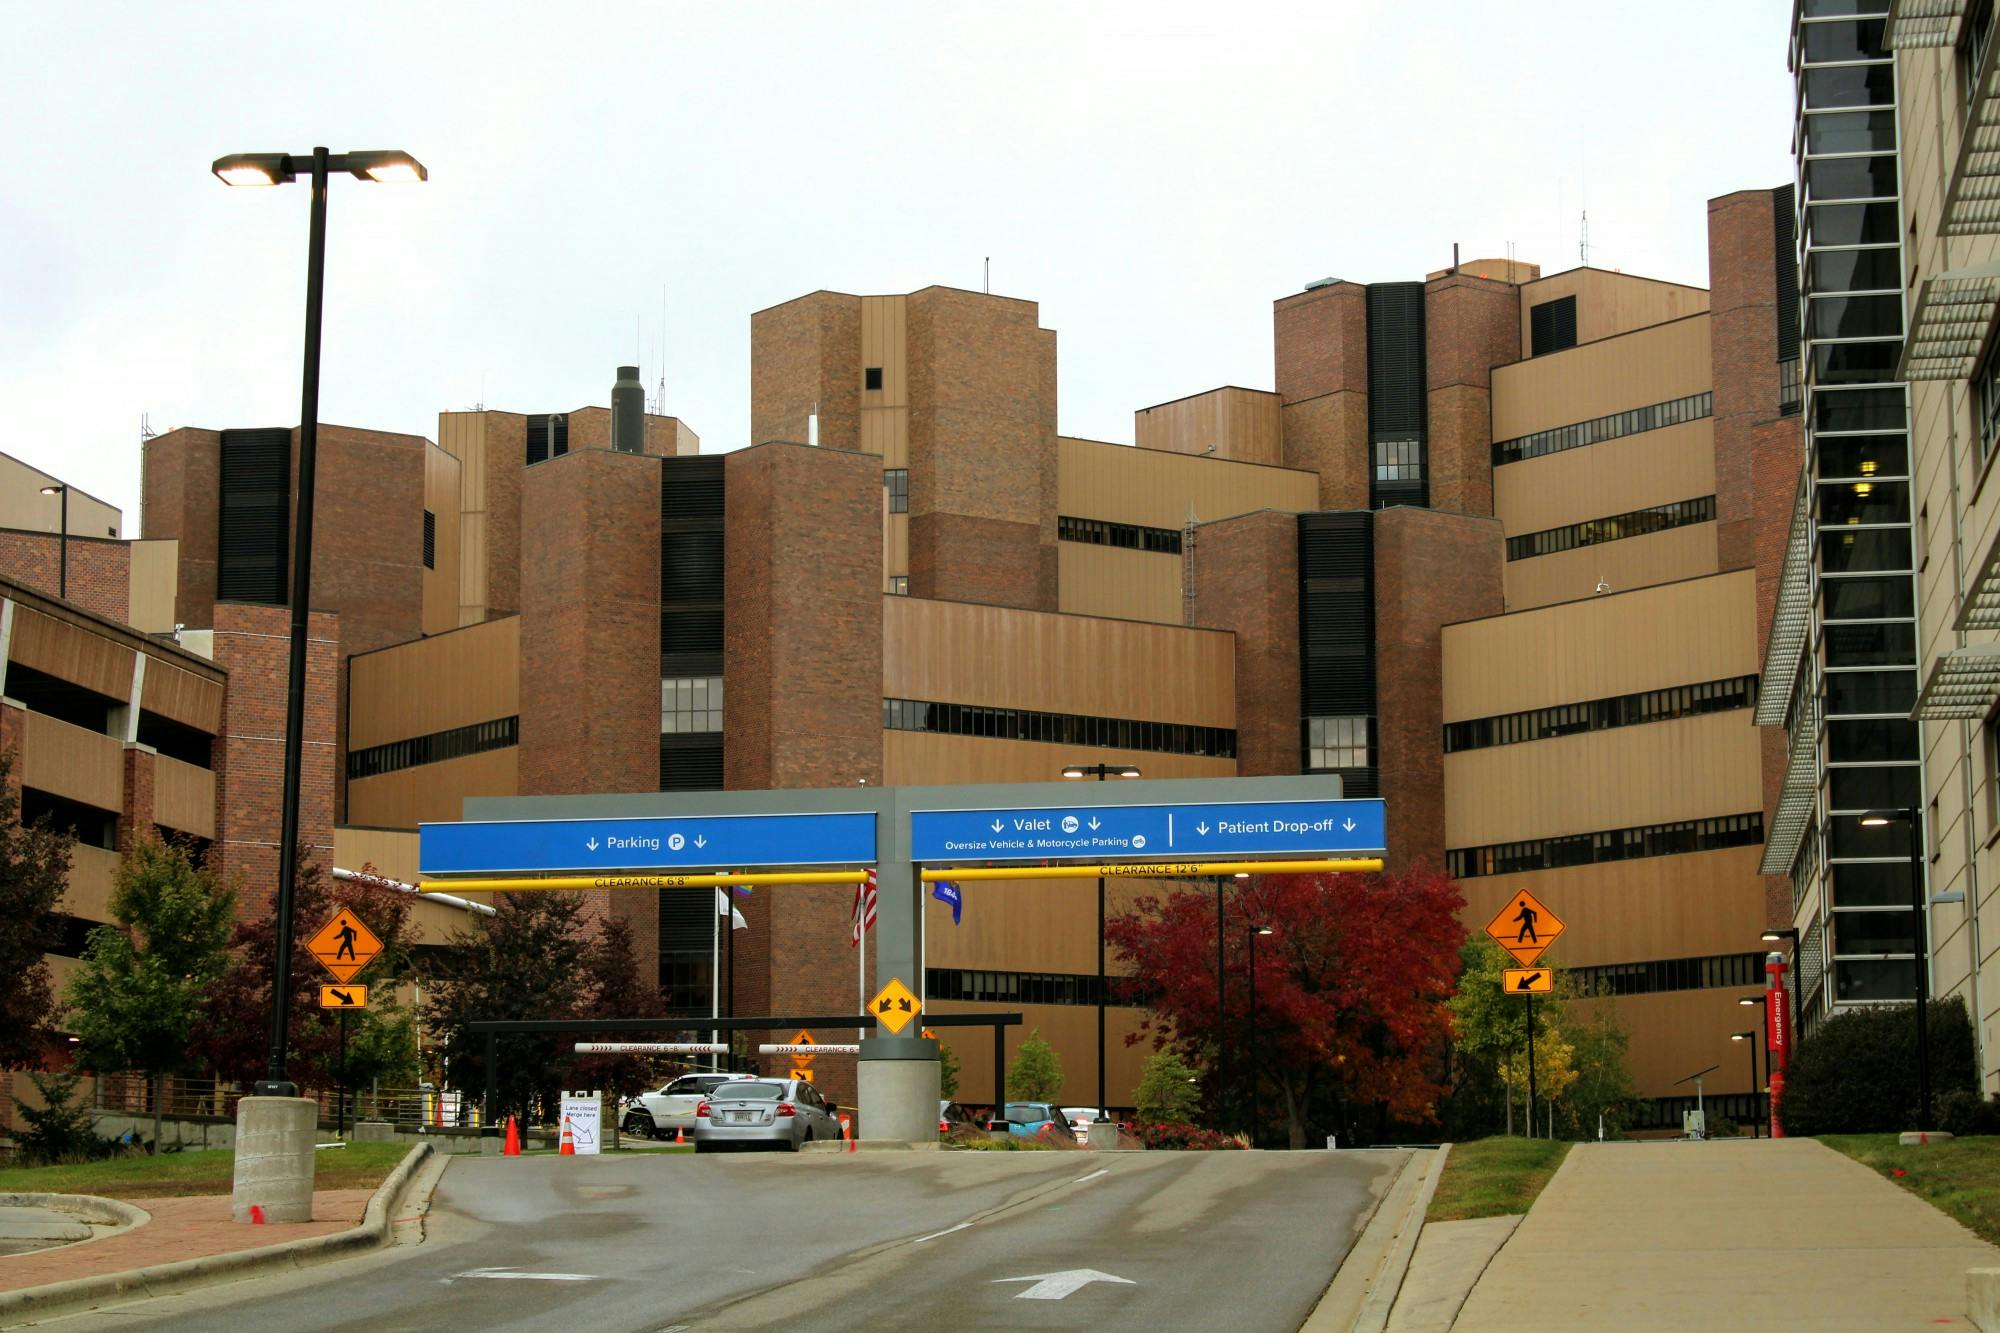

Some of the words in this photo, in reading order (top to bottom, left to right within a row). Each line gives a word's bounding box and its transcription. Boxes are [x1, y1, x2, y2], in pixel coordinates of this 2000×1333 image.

[1014, 818, 1051, 831] Valet
[1218, 821, 1270, 834] Patient
[1273, 819, 1334, 835] Drop-off
[607, 836, 660, 850] Parking
[945, 840, 987, 850] Oversize
[989, 839, 1026, 849] Vehicle
[1027, 839, 1034, 848] &
[1036, 837, 1090, 849] Motorcycle
[1092, 837, 1129, 849] Parking
[1100, 865, 1172, 876] CLEARANCE
[1175, 863, 1204, 874] 12'6"
[594, 877, 664, 888] CLEARANCE
[667, 876, 690, 886] 6'8"
[1774, 992, 1782, 1045] Emergency
